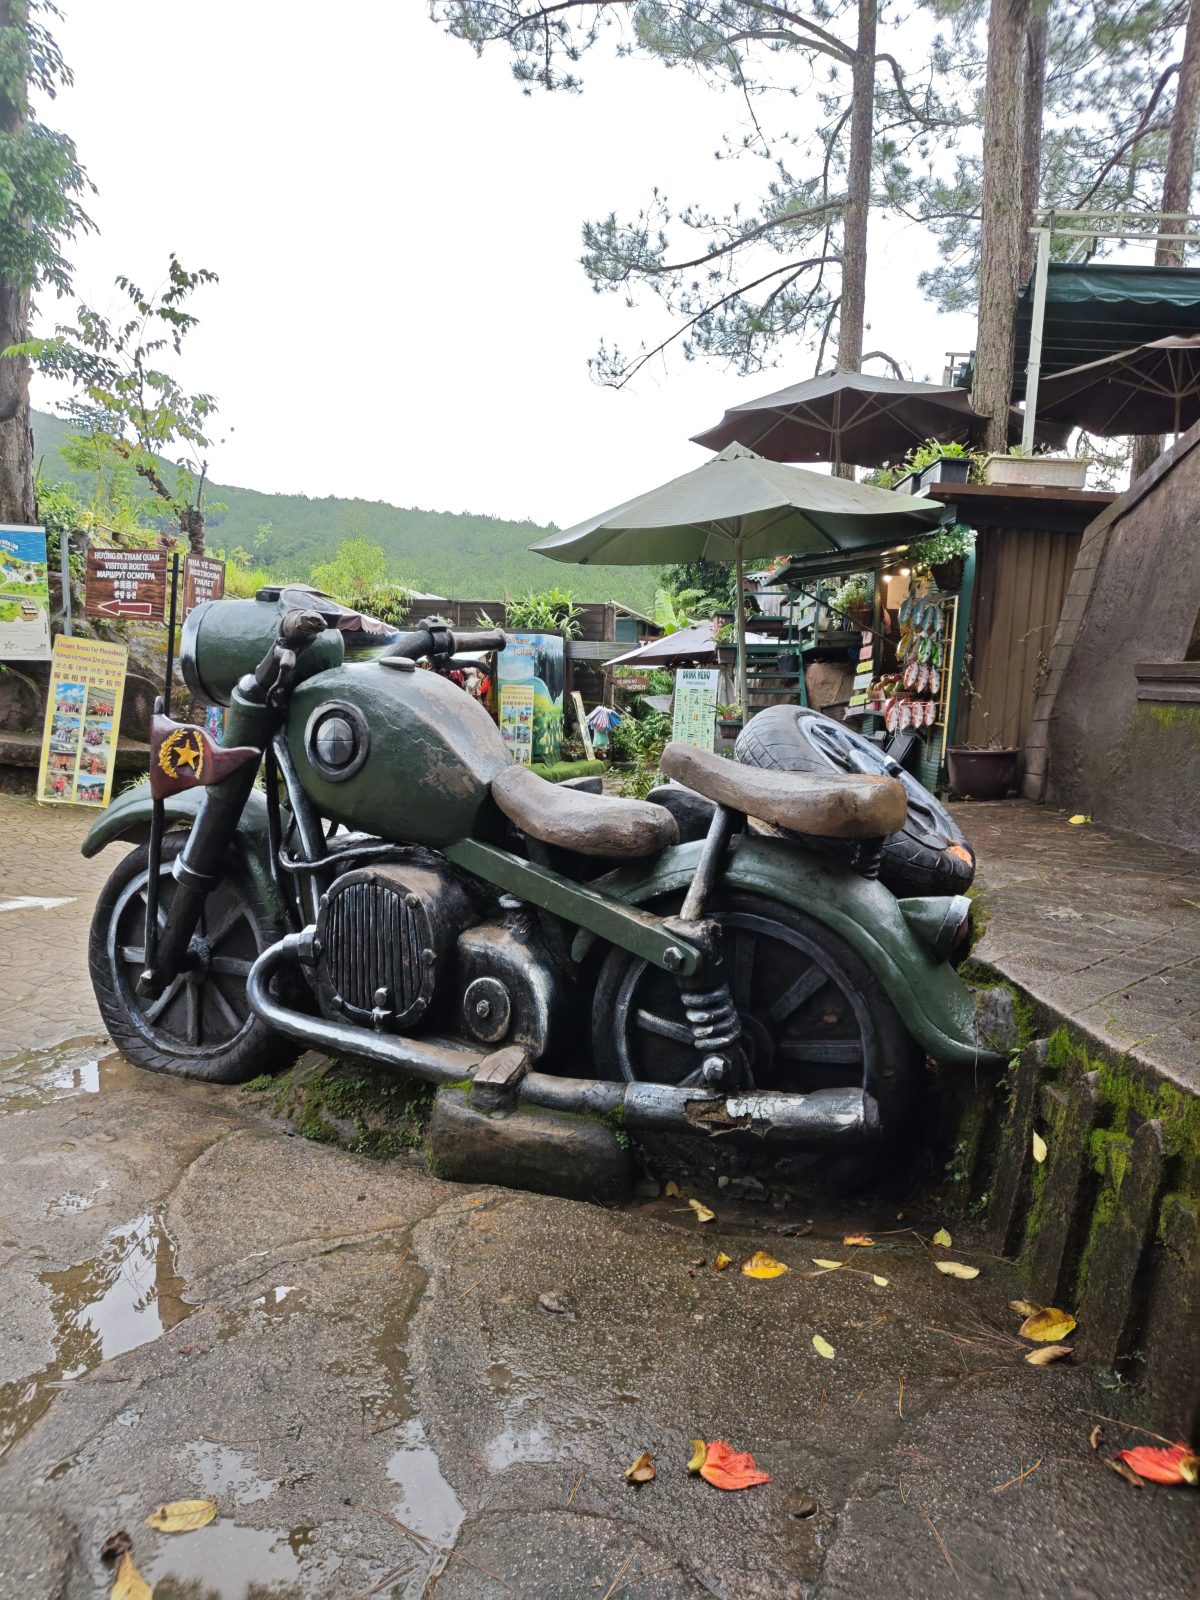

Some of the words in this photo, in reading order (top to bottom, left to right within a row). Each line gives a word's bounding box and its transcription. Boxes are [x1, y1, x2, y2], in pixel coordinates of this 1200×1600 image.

[123, 552, 142, 561] THAM
[142, 553, 160, 561] QUAN
[105, 562, 128, 570] VISITOR
[129, 563, 149, 571] ROUTE
[96, 570, 126, 579] МАРШРУТ
[127, 572, 155, 580] ОСМОТРА
[190, 568, 220, 580] RESTROOM
[194, 578, 214, 587] ТУАЛЕТ
[76, 644, 91, 652] Rental
[683, 670, 697, 680] DRINK
[697, 670, 711, 680] MENU
